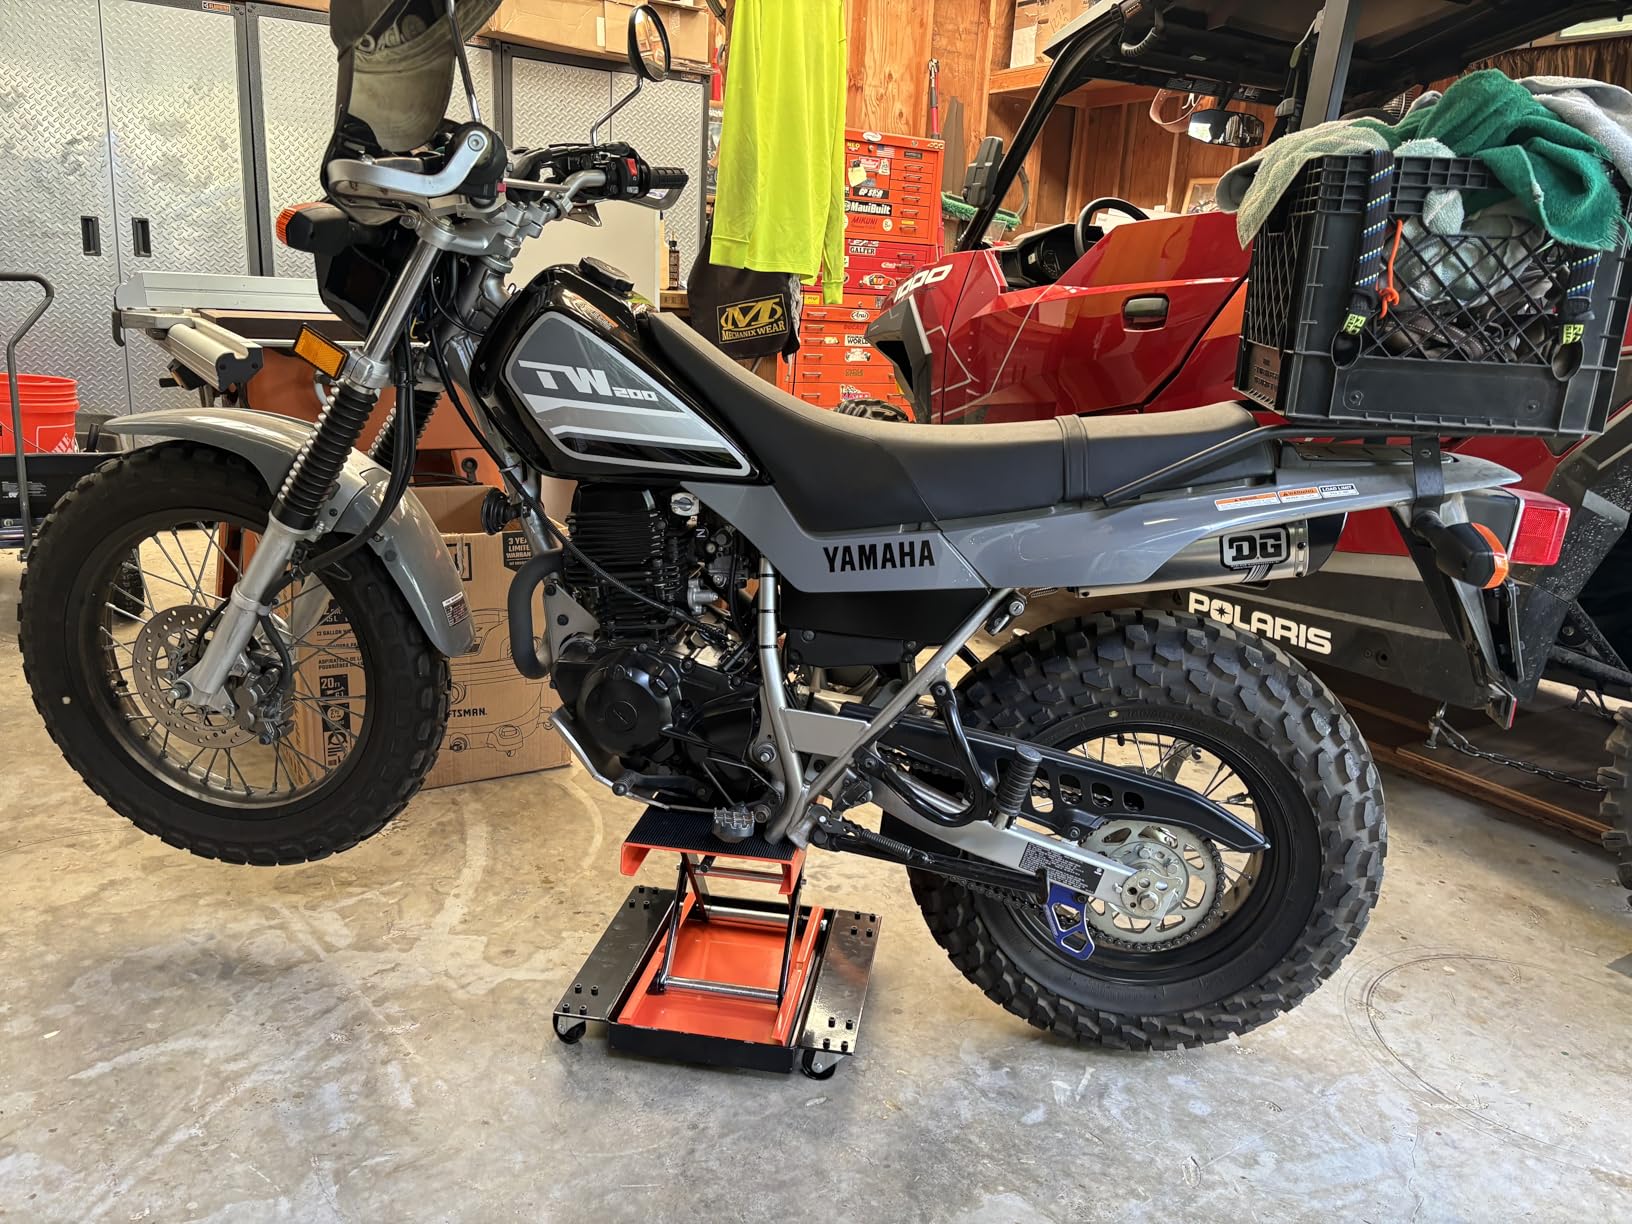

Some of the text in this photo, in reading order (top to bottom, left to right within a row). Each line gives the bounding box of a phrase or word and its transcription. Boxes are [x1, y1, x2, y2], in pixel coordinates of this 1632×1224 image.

[850, 202, 891, 215] MauiBuilt
[850, 246, 875, 254] GALFER
[893, 263, 953, 303] 1000
[722, 320, 785, 341] MECHANIX WEAR
[518, 359, 659, 402] TW 200
[823, 540, 935, 573] YAMAHA
[1188, 591, 1332, 655] POLARIS
[321, 677, 334, 689] 20
[448, 708, 487, 717] FTSMAN.
